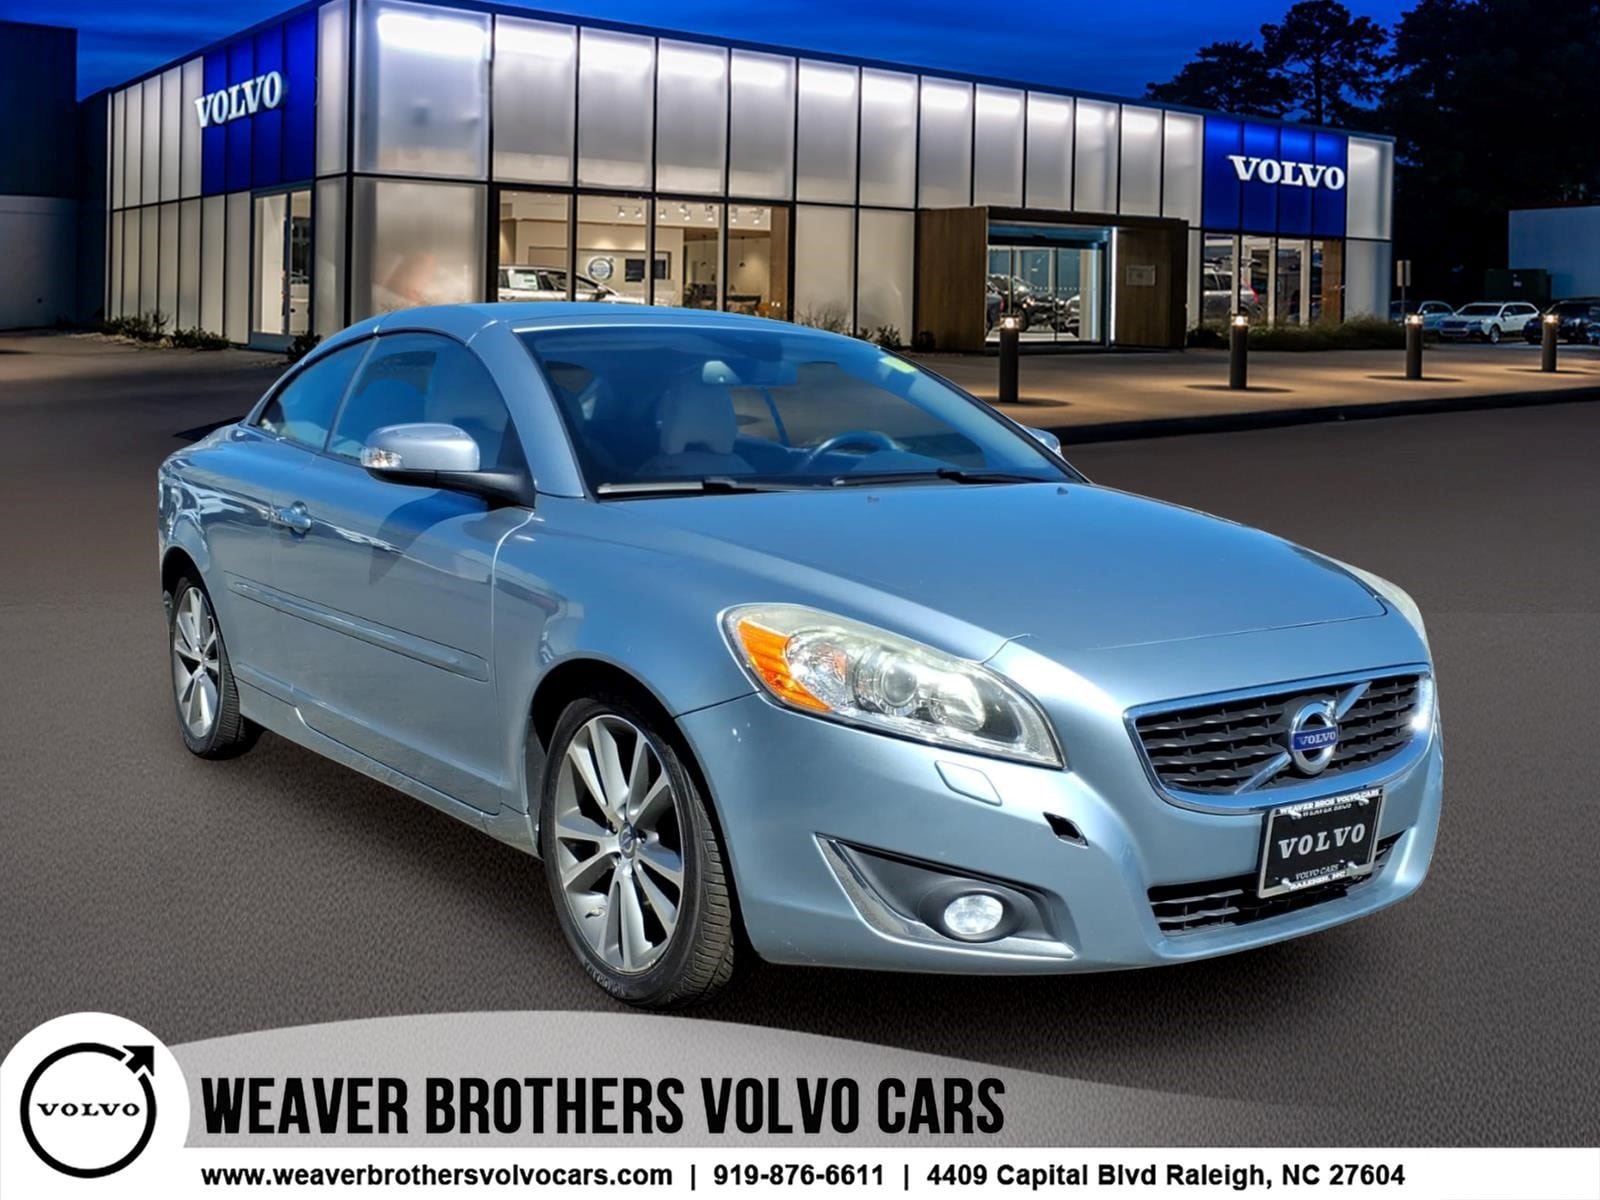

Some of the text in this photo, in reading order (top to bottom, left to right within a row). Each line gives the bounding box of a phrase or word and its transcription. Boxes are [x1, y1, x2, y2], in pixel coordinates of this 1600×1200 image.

[194, 71, 282, 128] VOLVO
[1228, 155, 1345, 190] VOLVO
[1297, 731, 1336, 745] VOLVO
[1278, 823, 1366, 860] VOLVO
[1296, 869, 1320, 880] VOLVO
